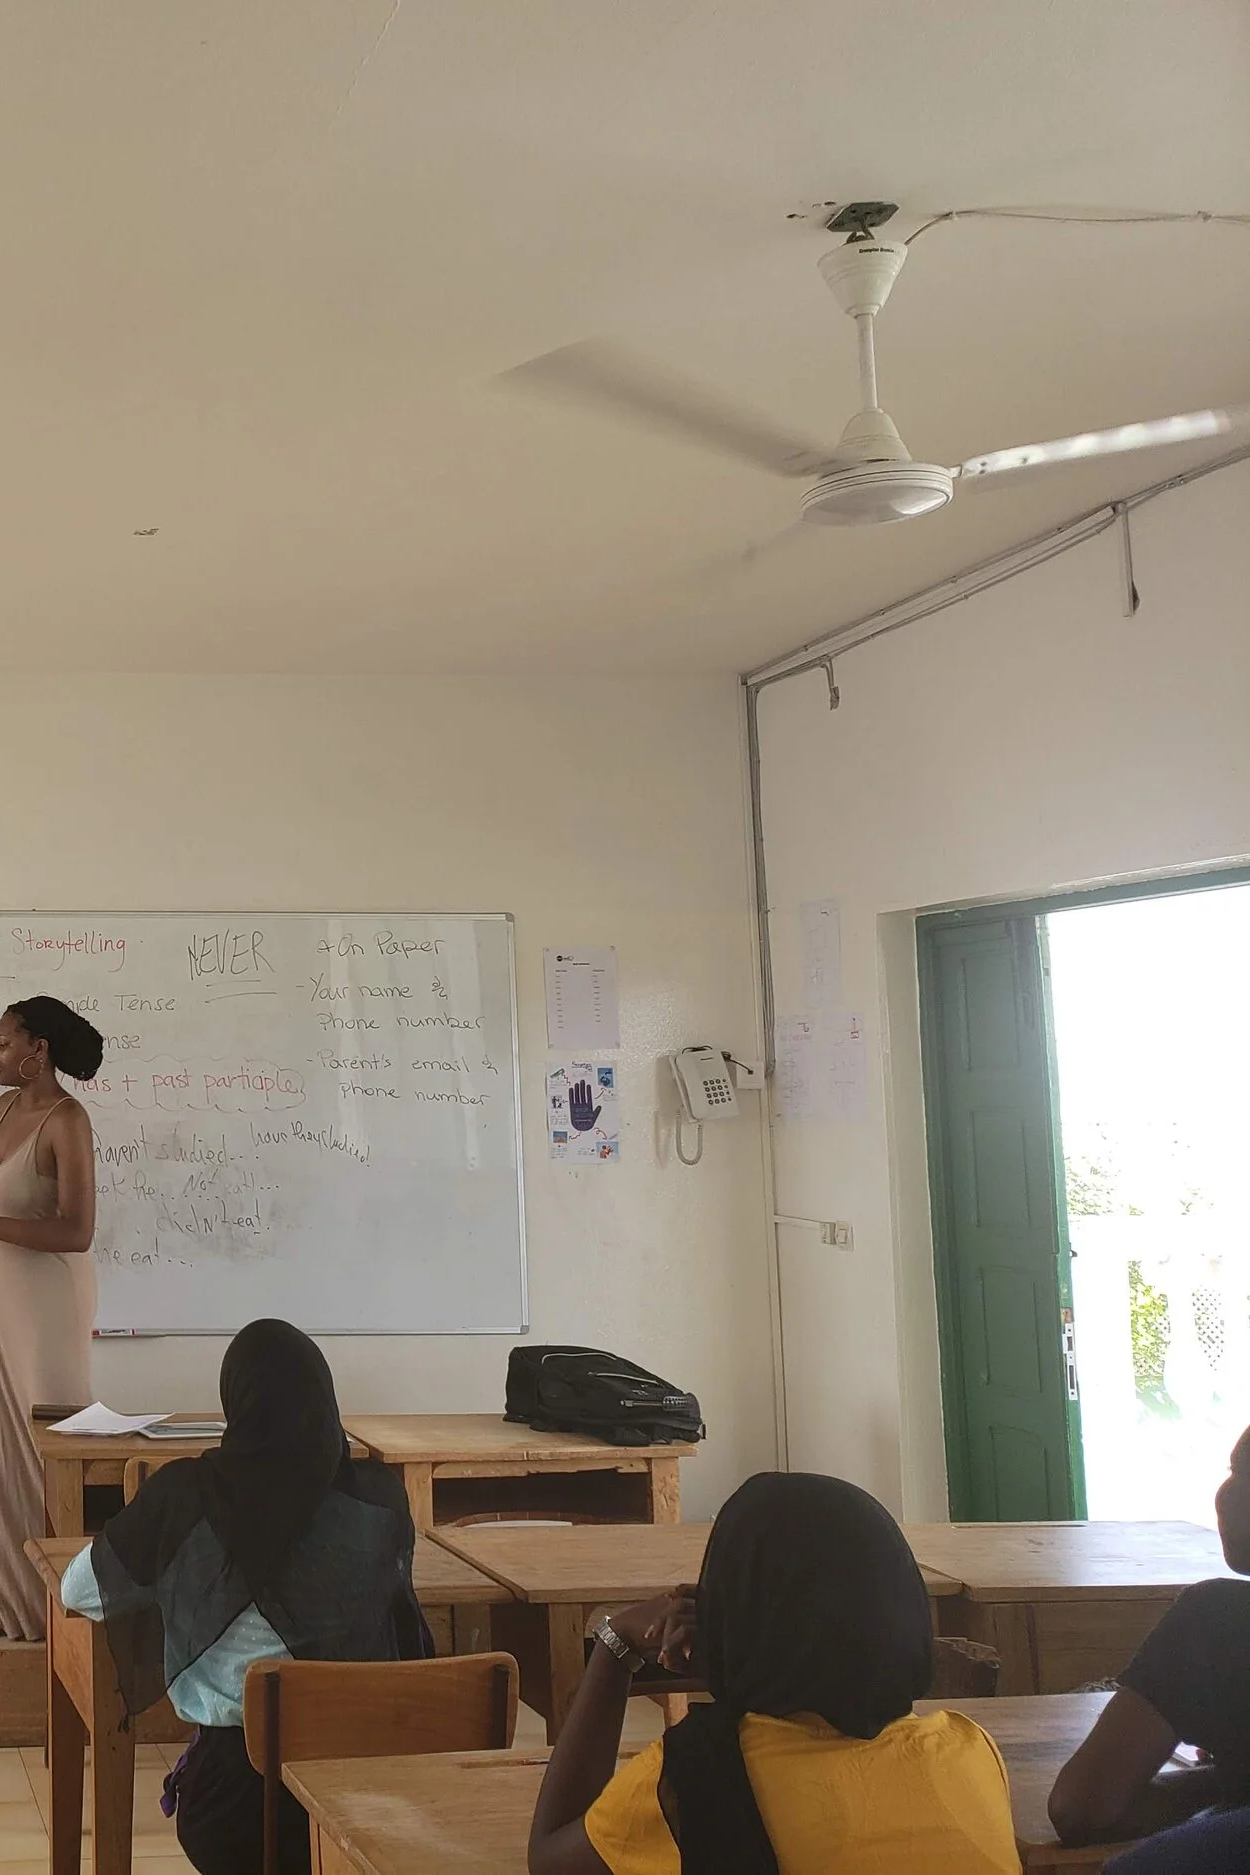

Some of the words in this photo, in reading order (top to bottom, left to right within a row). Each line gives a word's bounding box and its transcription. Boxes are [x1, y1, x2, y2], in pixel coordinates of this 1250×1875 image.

[11, 924, 126, 973] Storytelling
[188, 929, 275, 980] NEVER
[374, 930, 446, 959] Paper
[358, 985, 414, 999] name
[114, 993, 176, 1013] Tense
[396, 1011, 486, 1030] number
[411, 1055, 470, 1073] email
[151, 1068, 194, 1101] past
[414, 1088, 491, 1106] number
